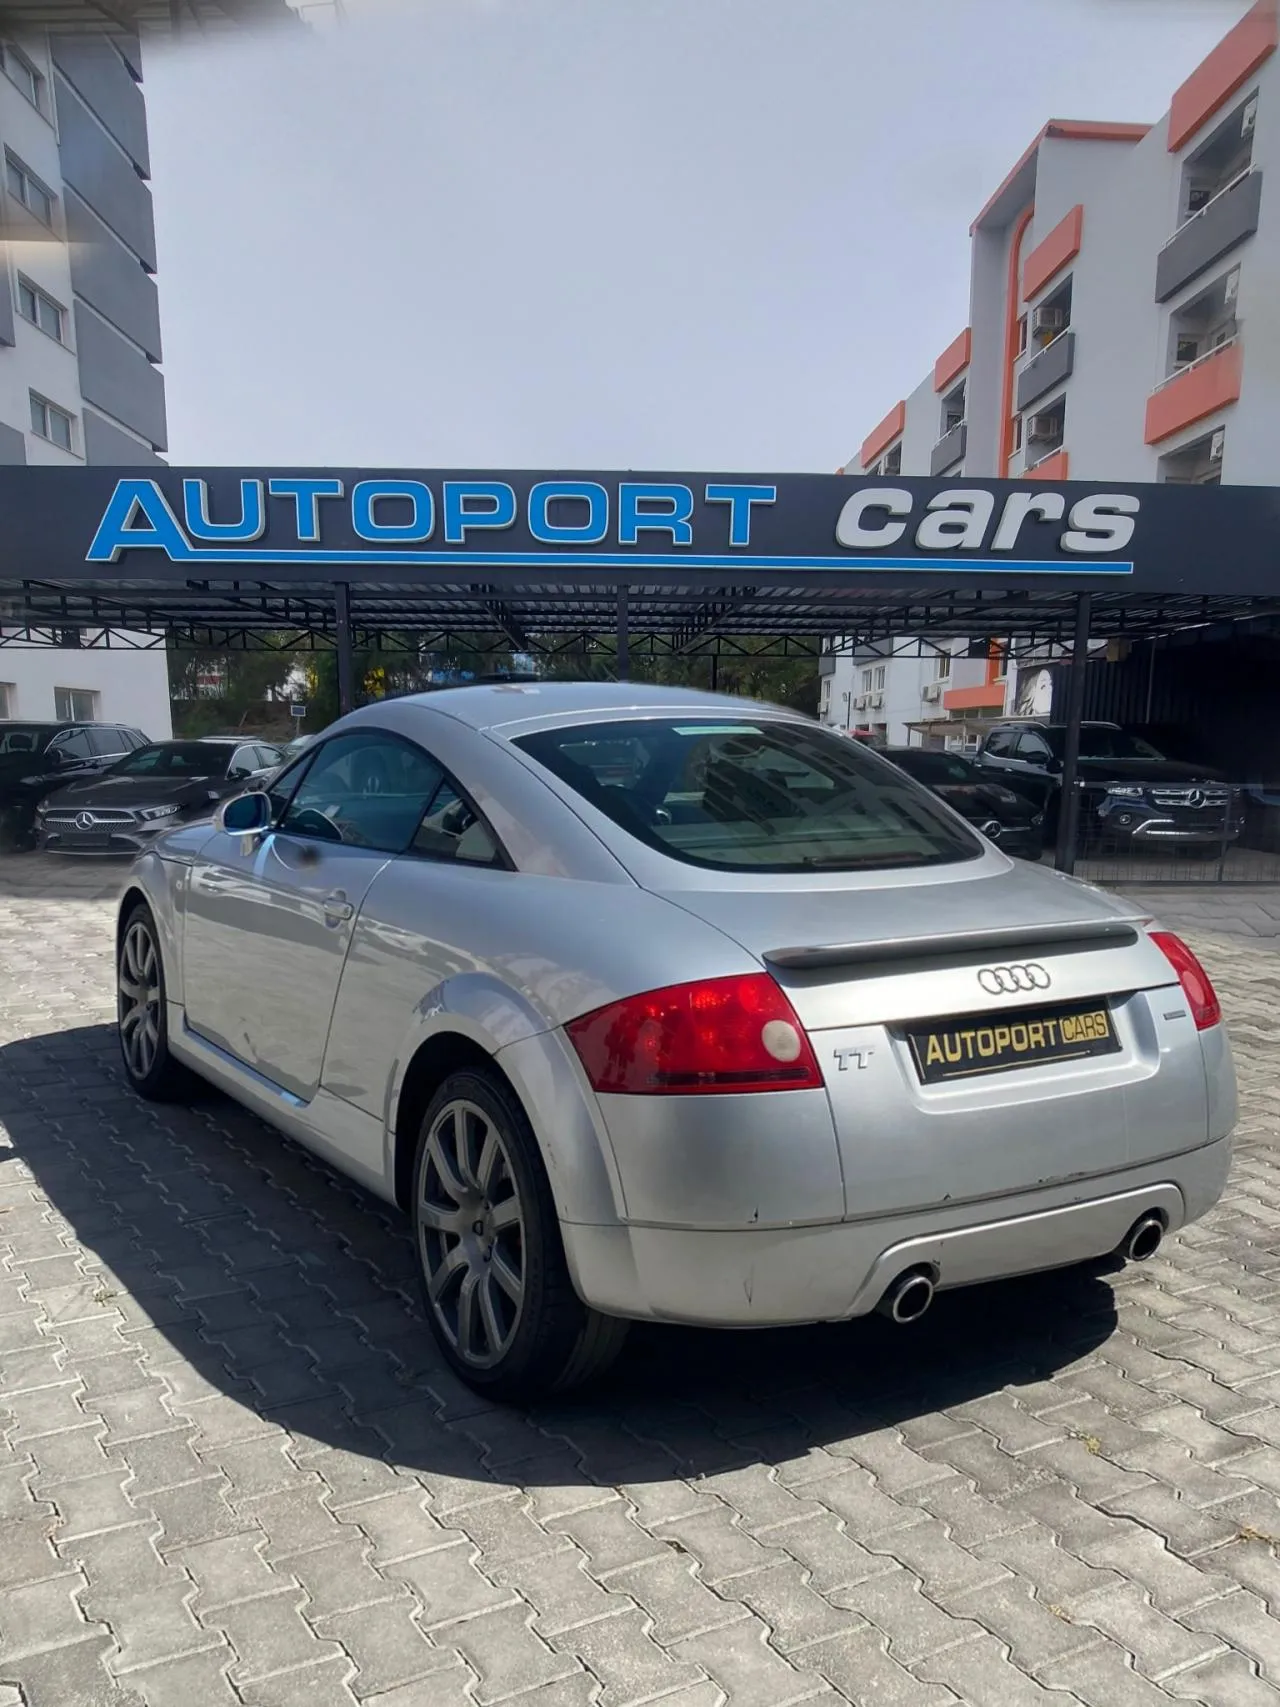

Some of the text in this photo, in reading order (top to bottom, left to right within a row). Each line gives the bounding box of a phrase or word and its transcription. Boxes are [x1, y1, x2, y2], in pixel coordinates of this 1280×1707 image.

[85, 478, 1141, 562] AUTOPORT cars
[833, 1045, 875, 1071] TT
[926, 1012, 1108, 1066] AUTOPORT CARS
